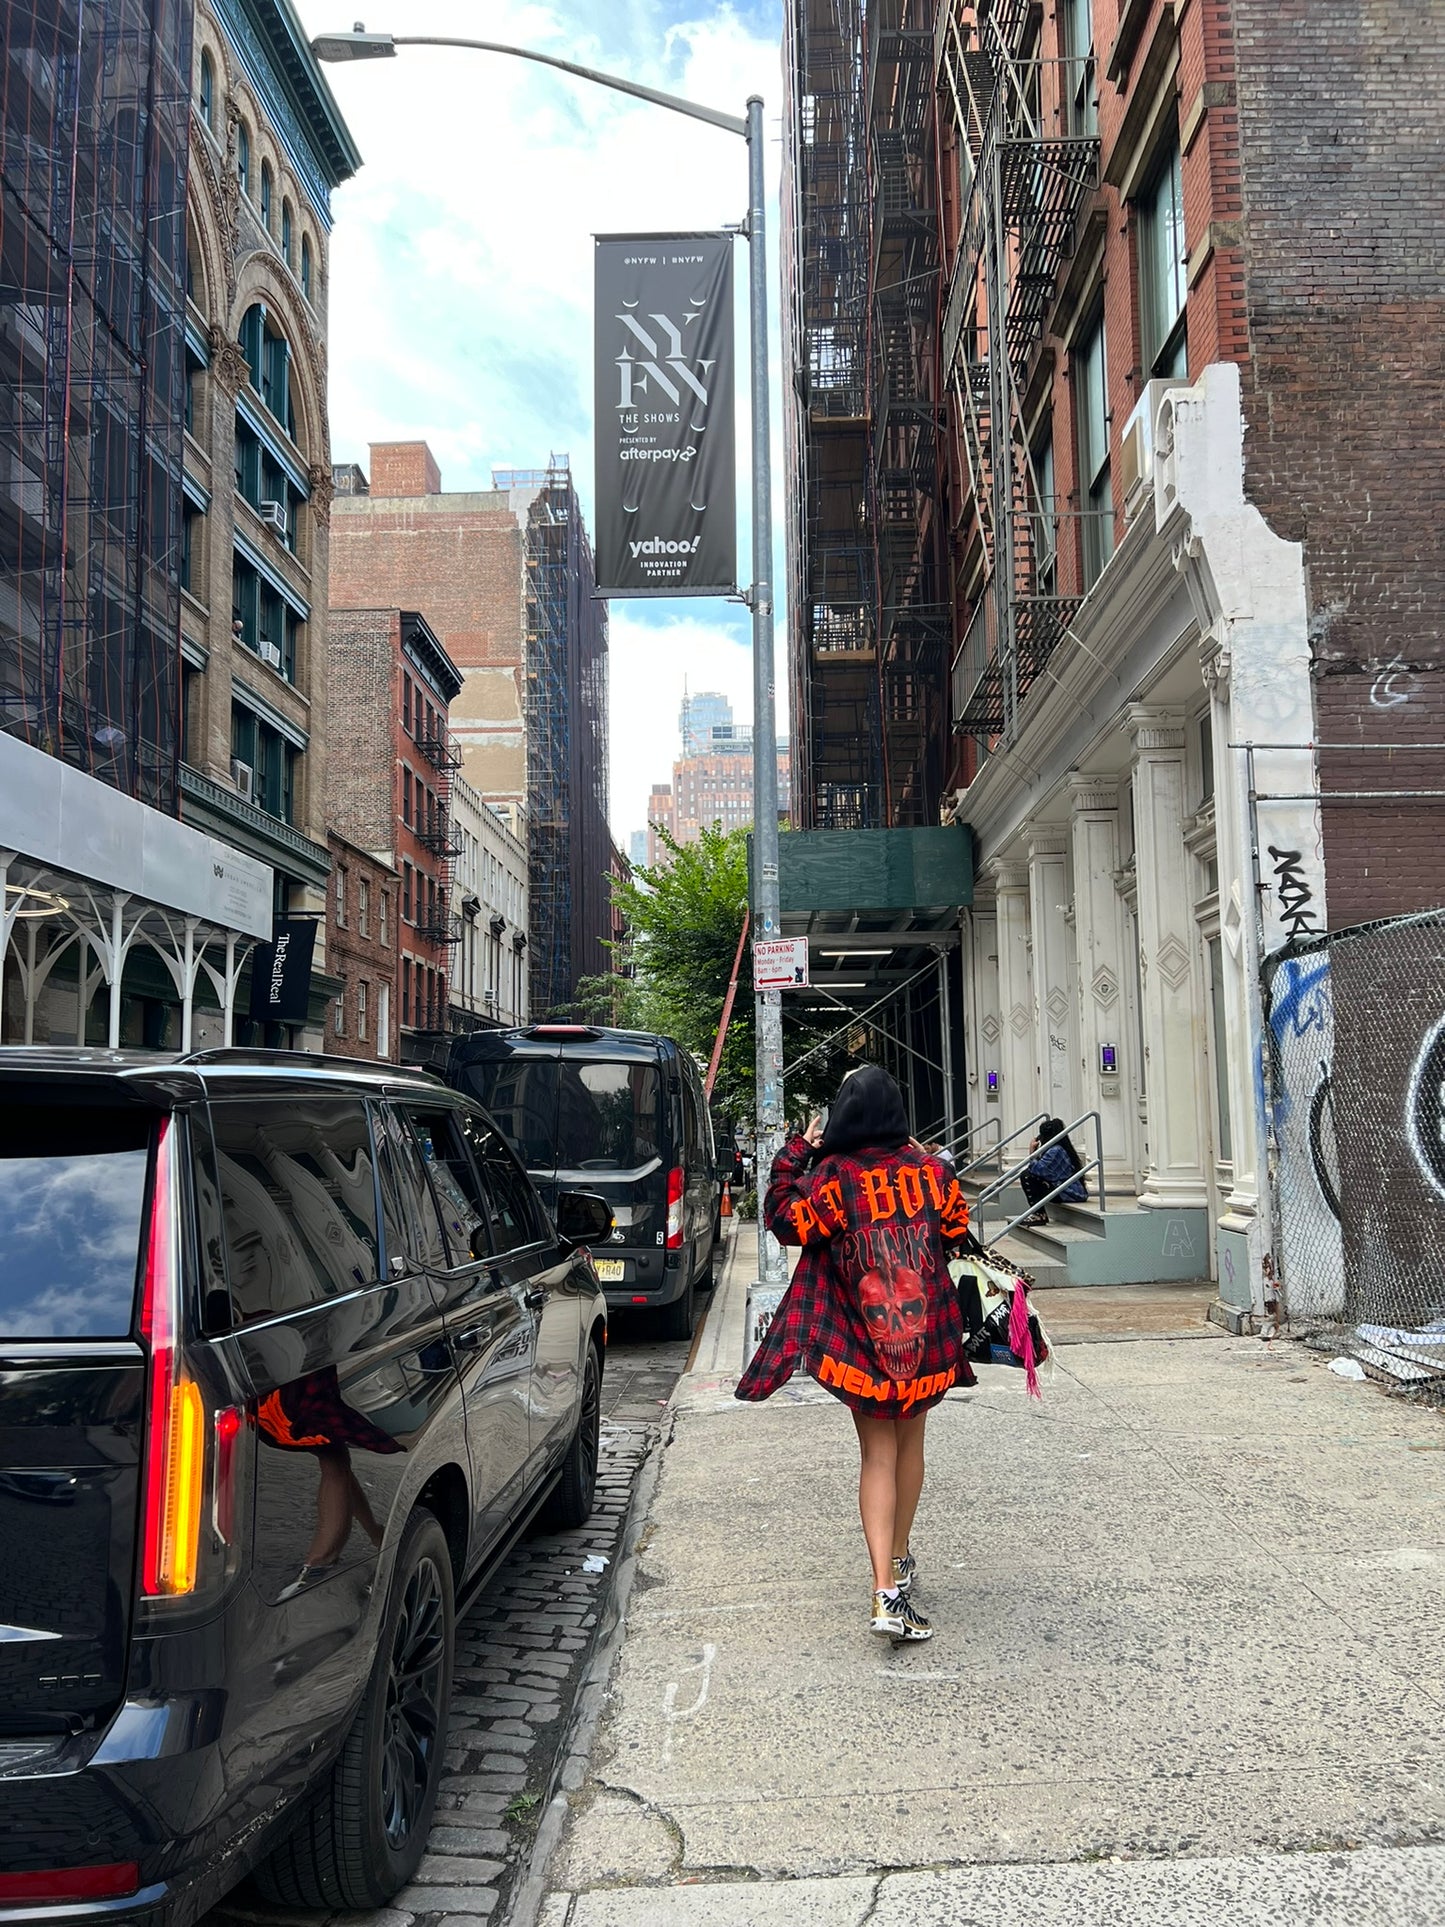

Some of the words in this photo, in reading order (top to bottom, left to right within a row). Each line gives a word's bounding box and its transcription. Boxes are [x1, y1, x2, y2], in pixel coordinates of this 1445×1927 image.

[624, 257, 657, 265] @NYFW
[619, 413, 639, 424] THE
[644, 412, 680, 423] SHOWS
[619, 446, 681, 463] afterpay
[629, 535, 701, 558] yahoo!
[640, 560, 688, 568] INNOVATION
[646, 568, 681, 576] PARTNER
[757, 947, 766, 955] NO
[768, 944, 794, 954] PARKING
[757, 958, 775, 966] Monday
[779, 956, 794, 964] Friday
[657, 1232, 663, 1244] 5
[840, 1222, 937, 1278] PUNK
[818, 1354, 891, 1402] NEW
